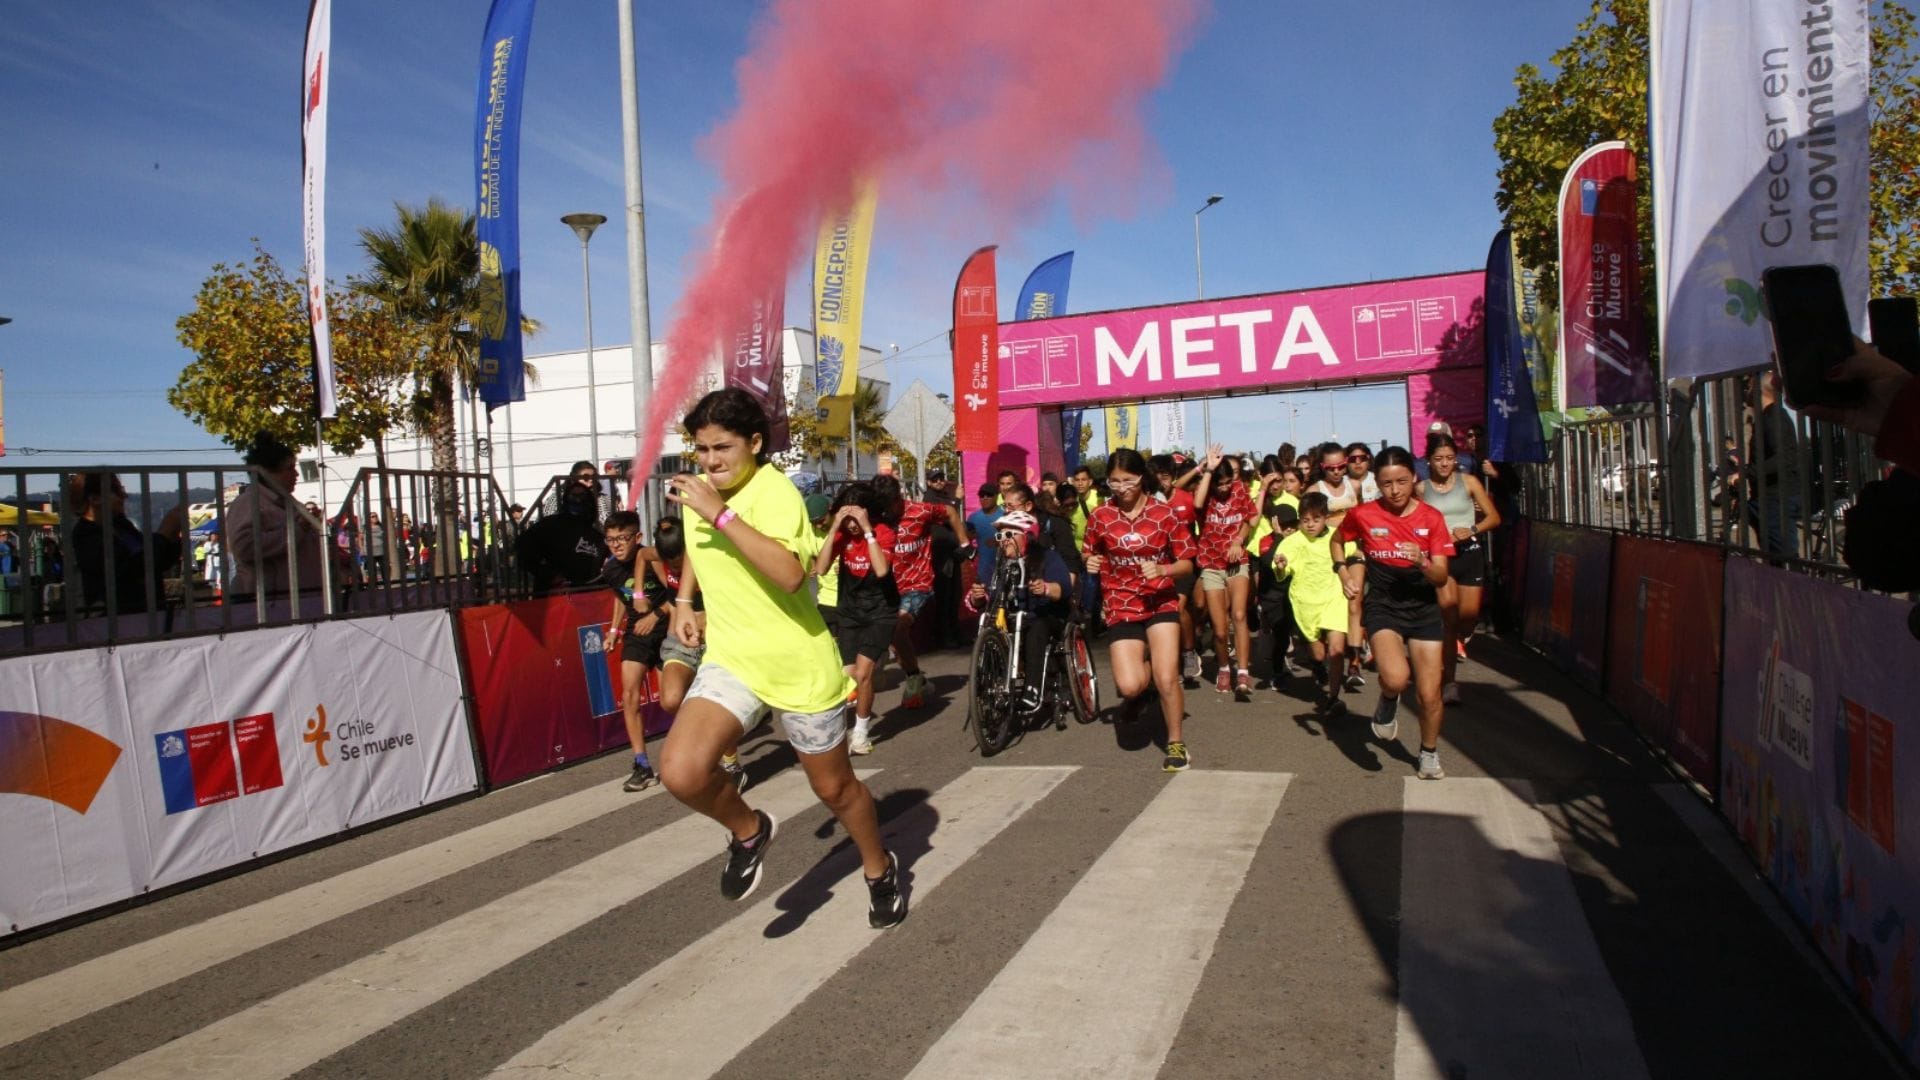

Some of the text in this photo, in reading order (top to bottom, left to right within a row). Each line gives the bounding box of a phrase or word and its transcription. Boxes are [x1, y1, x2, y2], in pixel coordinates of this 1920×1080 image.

[490, 153, 500, 170] DE
[491, 133, 502, 151] LA
[1760, 47, 1792, 248] Crecer en
[489, 172, 500, 219] CIUDAD
[1586, 242, 1605, 318] Chile se
[1606, 253, 1621, 320] Mueve
[749, 299, 762, 366] Mueve
[1094, 305, 1341, 386] META
[972, 361, 981, 389] Chile
[980, 334, 989, 389] Se mueve
[337, 718, 375, 741] Chile
[340, 732, 414, 761] Se mueve
